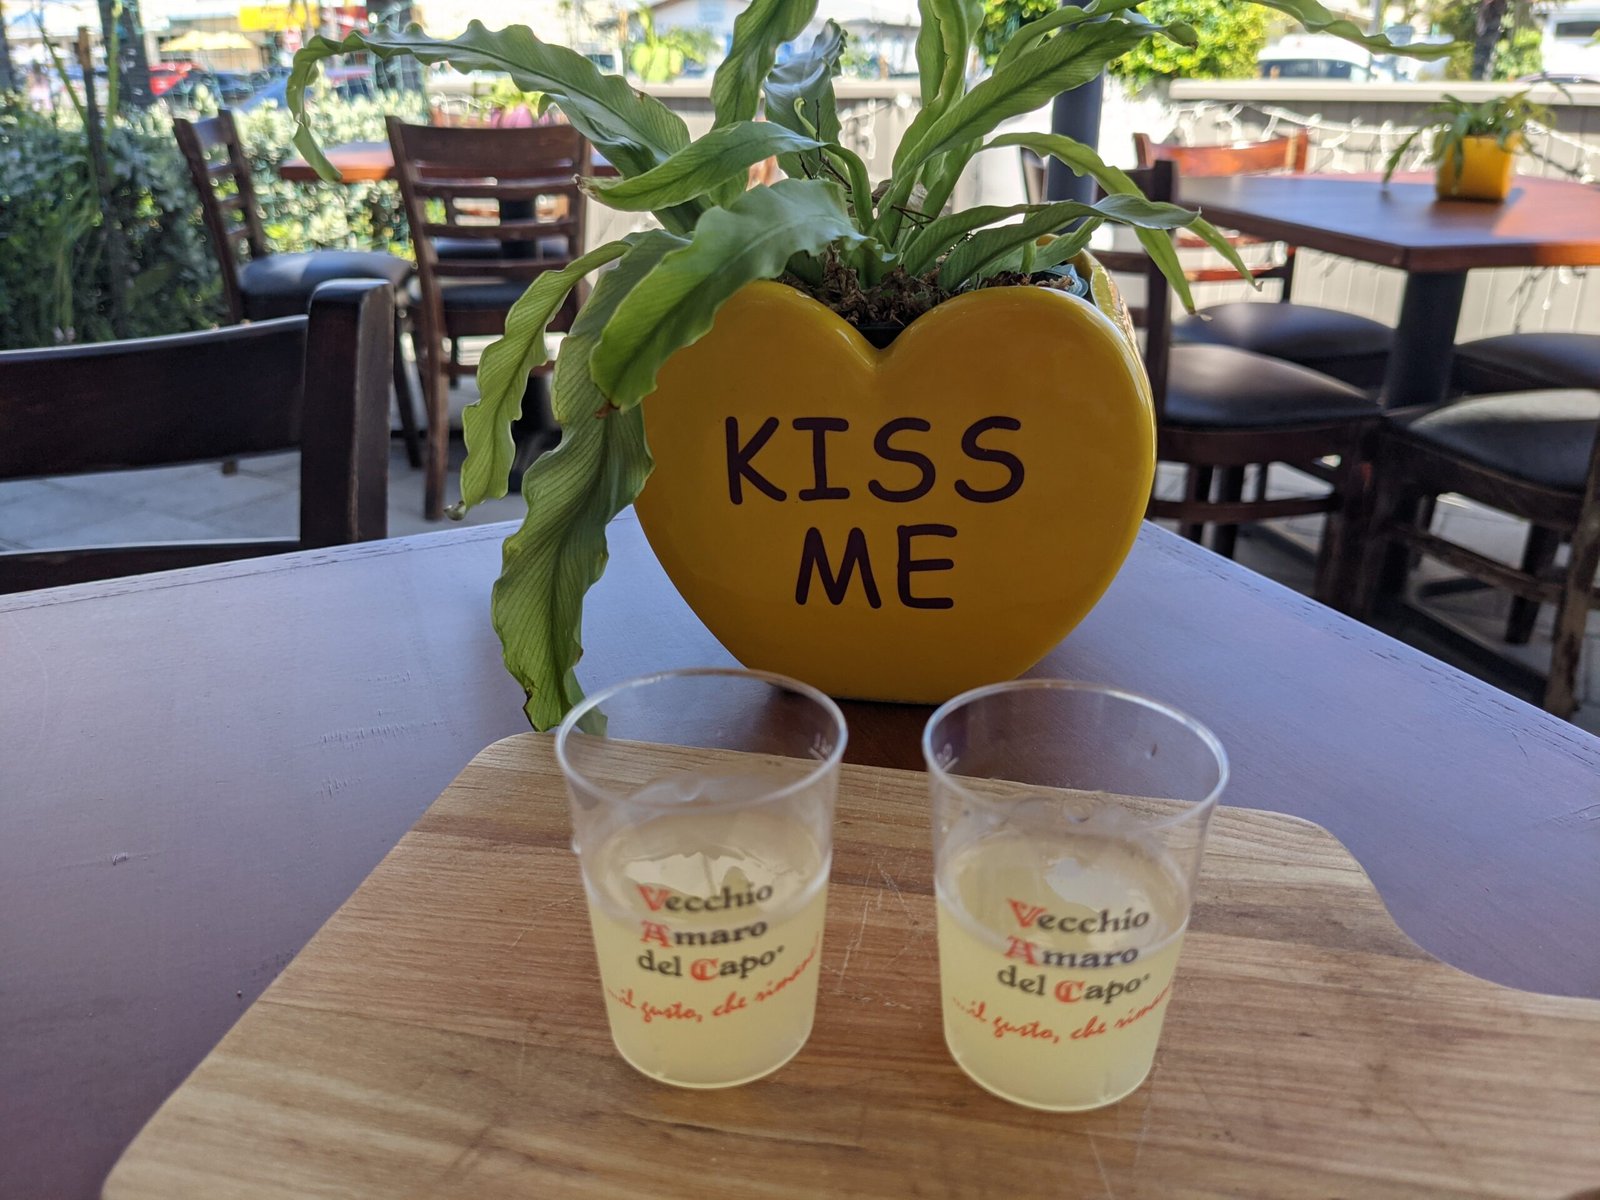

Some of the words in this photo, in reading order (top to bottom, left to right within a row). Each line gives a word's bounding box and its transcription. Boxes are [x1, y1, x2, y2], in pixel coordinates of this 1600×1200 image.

[725, 416, 1025, 505] KISS
[795, 523, 958, 610] ME
[636, 883, 774, 913] Vecchio
[1007, 898, 1150, 934] Vecchio
[640, 920, 768, 948] Amaro
[637, 949, 682, 977] del
[1003, 935, 1139, 968] Amaro
[997, 965, 1046, 996] del
[640, 1001, 702, 1023] gusto,
[712, 991, 747, 1018] che
[992, 1016, 1060, 1044] gusto,
[1070, 1015, 1106, 1040] che
